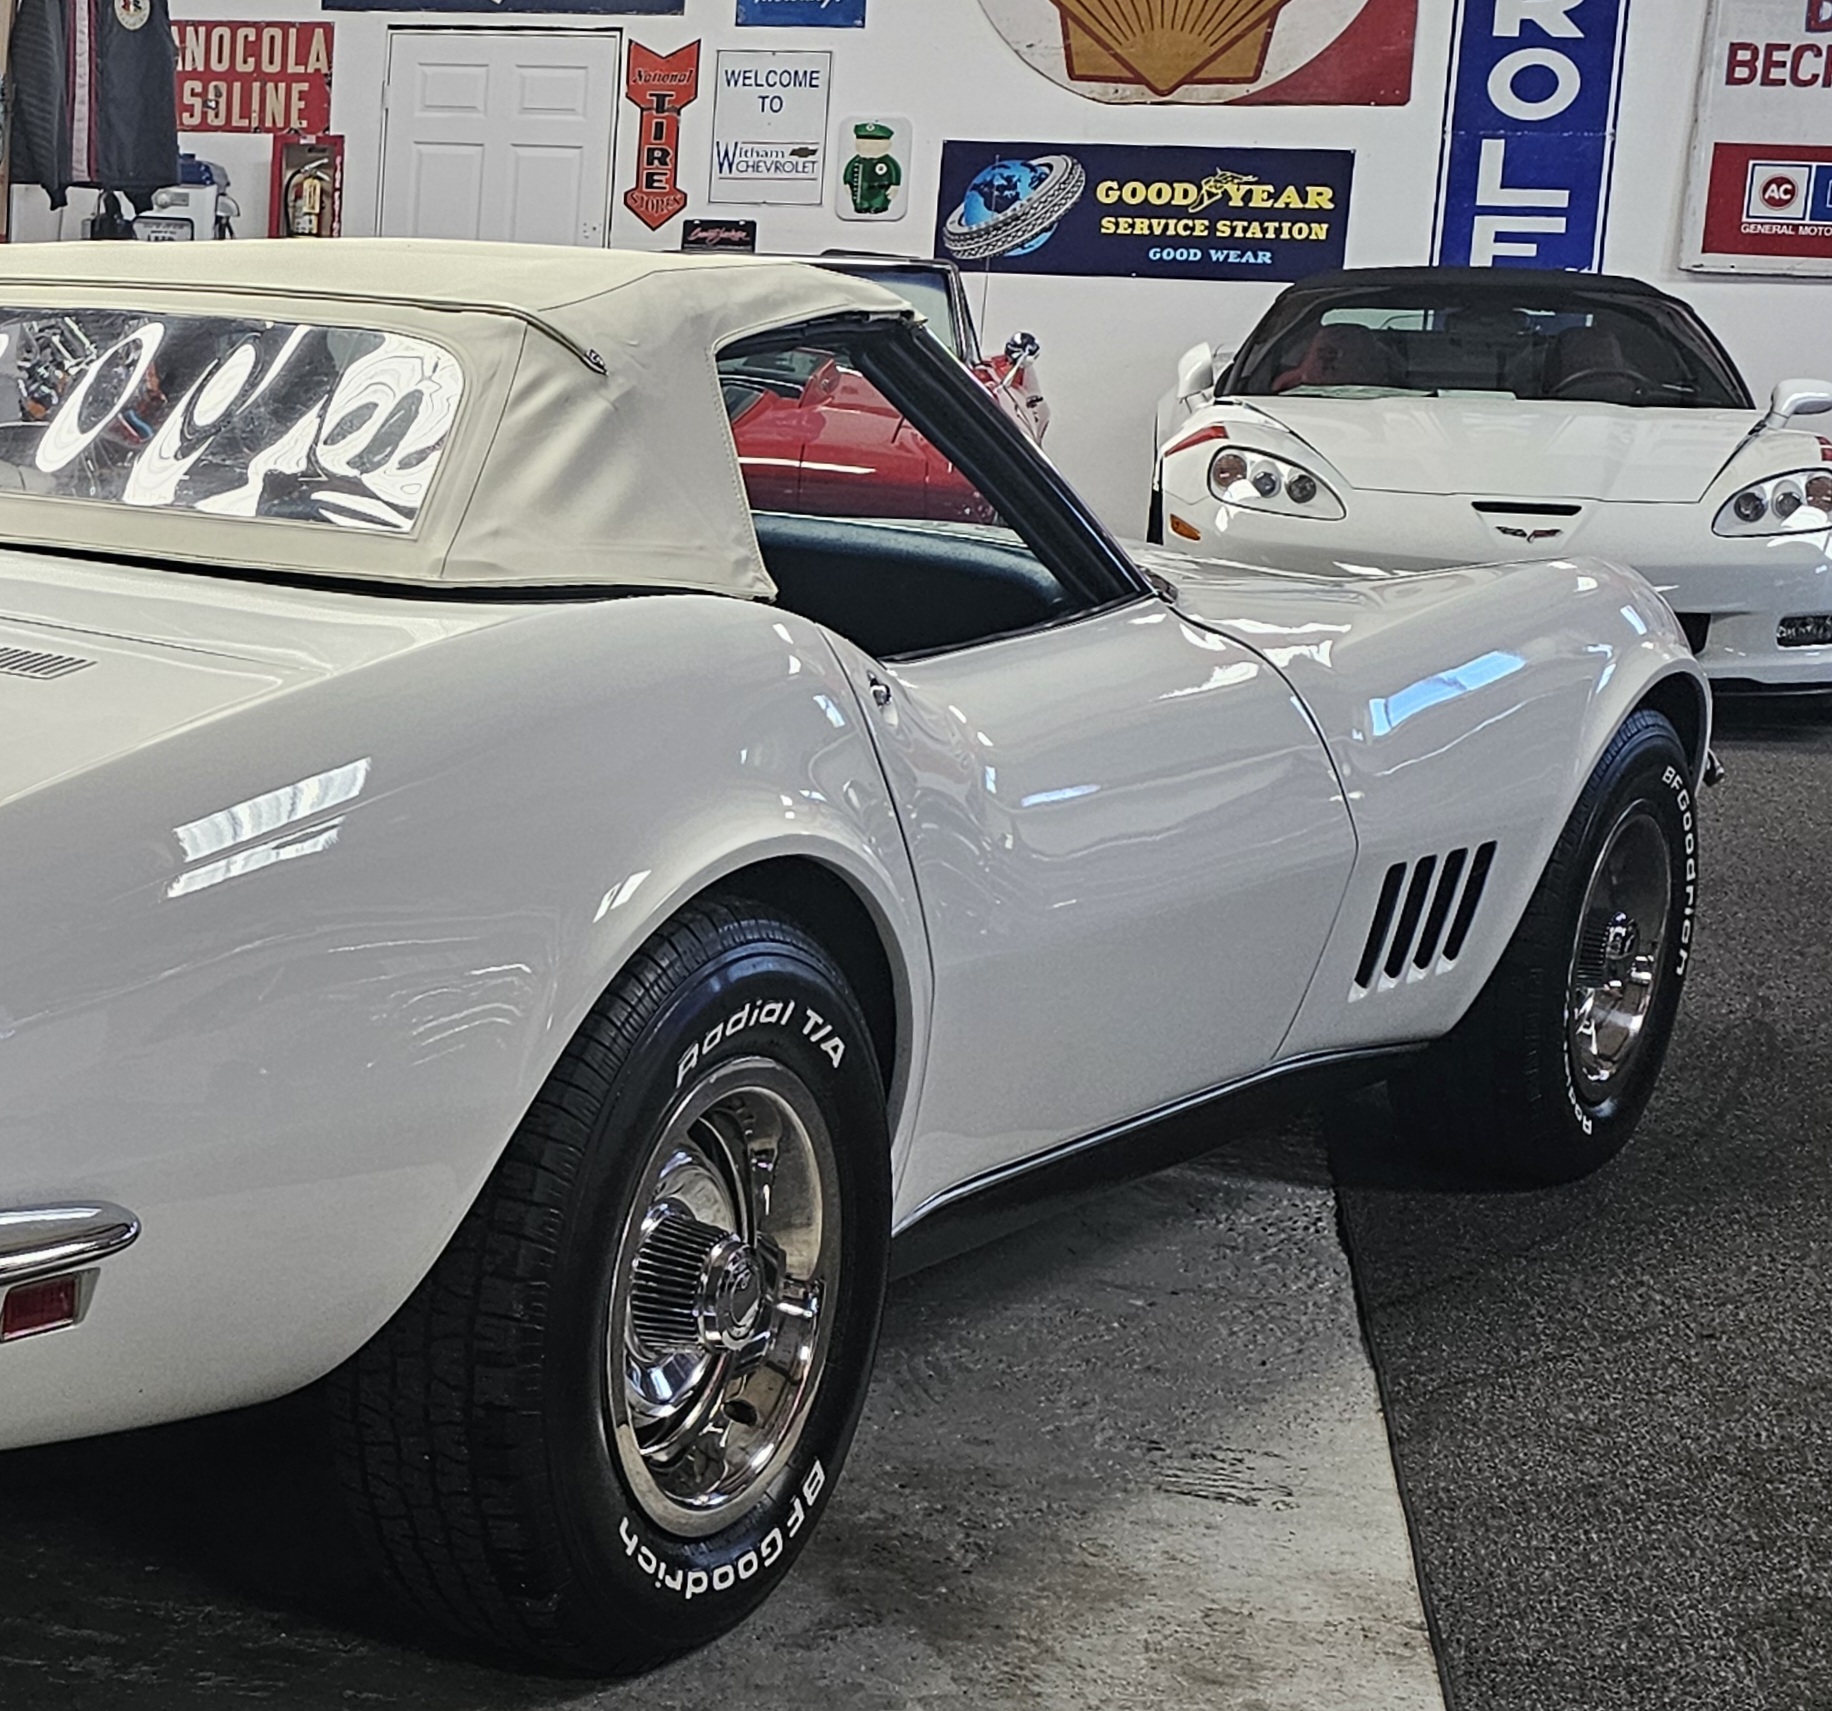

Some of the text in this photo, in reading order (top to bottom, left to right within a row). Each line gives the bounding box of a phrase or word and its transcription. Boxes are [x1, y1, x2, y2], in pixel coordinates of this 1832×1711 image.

[632, 68, 694, 85] National
[724, 69, 821, 88] WELCOME
[182, 80, 310, 129] SOLINE
[758, 95, 784, 113] TO
[643, 92, 675, 191] TIRE
[716, 141, 786, 175] Witham
[736, 160, 818, 174] CHEVROLET
[1764, 183, 1793, 200] AC
[1100, 216, 1329, 241] SERVICE STATION
[1740, 223, 1796, 235] GENERAL
[1148, 248, 1272, 265] GOOD WEAR
[676, 1000, 796, 1088] Radial
